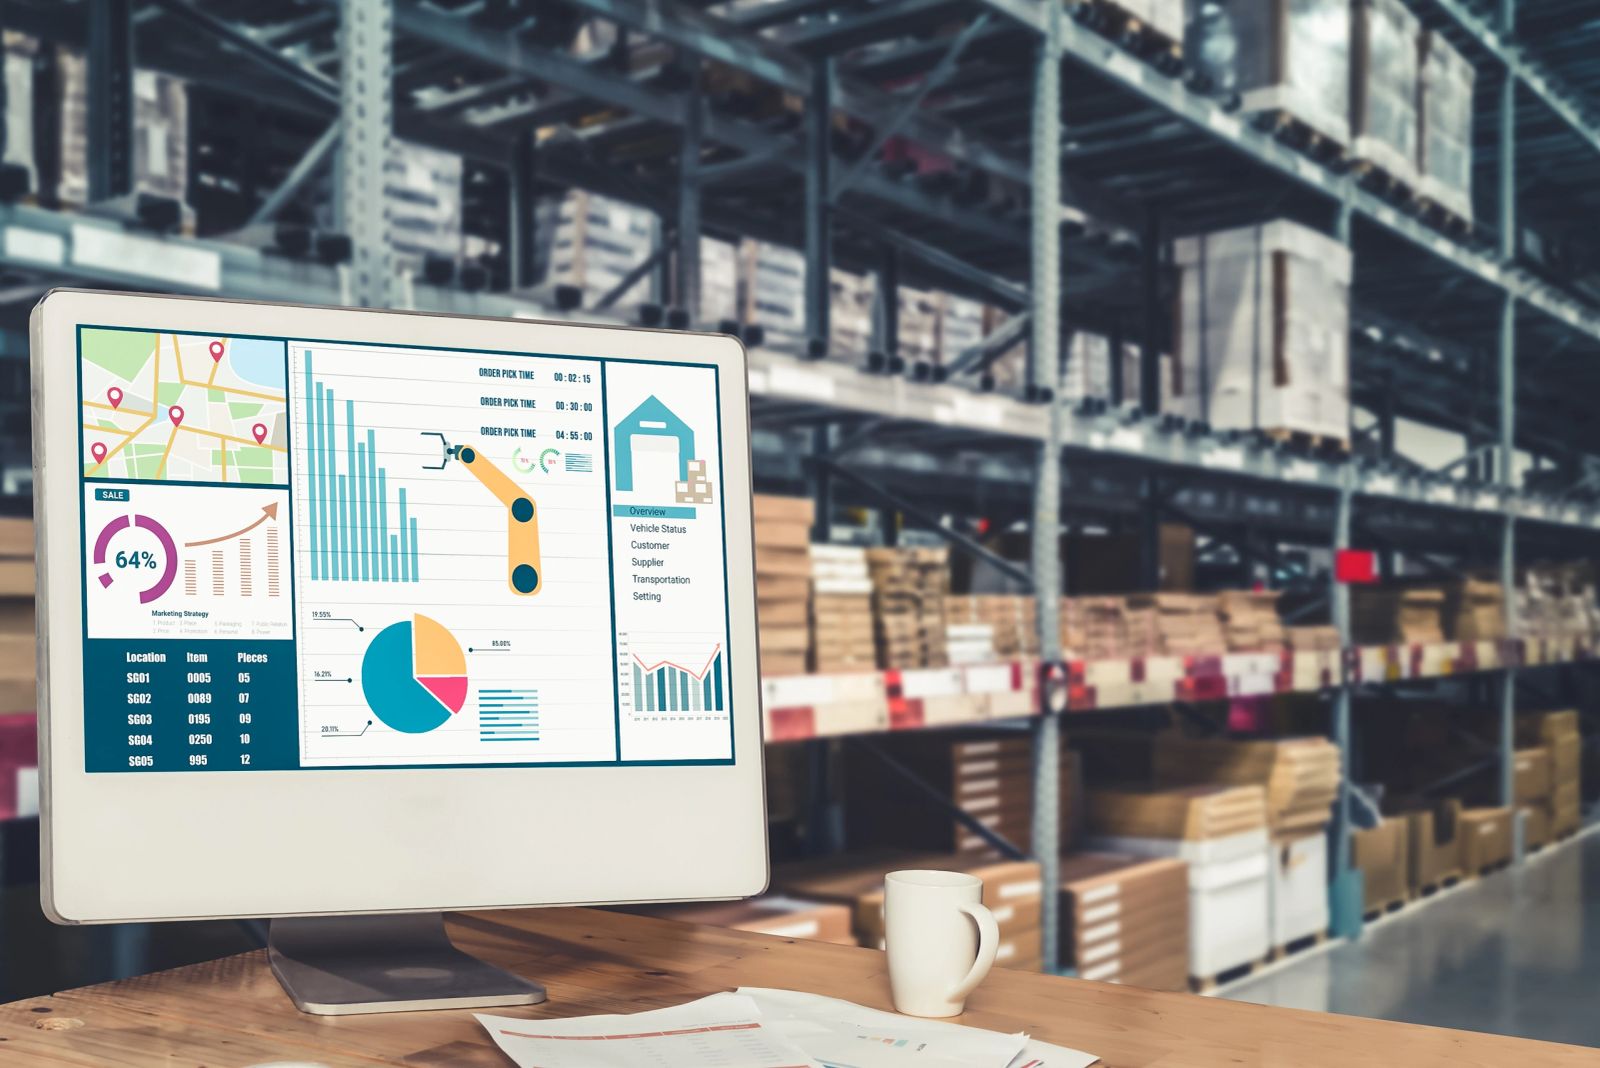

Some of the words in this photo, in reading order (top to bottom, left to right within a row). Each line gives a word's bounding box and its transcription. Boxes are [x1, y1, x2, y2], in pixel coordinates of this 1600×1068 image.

[479, 368, 500, 377] ORDER
[502, 369, 517, 378] PICK
[519, 370, 534, 379] TIME
[481, 397, 502, 406] ORDER
[504, 398, 518, 407] PICK
[520, 399, 536, 408] TIME
[481, 427, 502, 436] ORDER
[504, 428, 519, 437] PICK
[520, 429, 536, 438] TIME
[103, 491, 123, 499] SALE
[629, 506, 666, 516] Overview
[630, 524, 659, 532] Vehicle
[661, 525, 686, 533] Status
[631, 541, 669, 549] Customer
[116, 551, 156, 569] 64%
[632, 558, 664, 568] Supplier
[632, 575, 690, 585] Transportation
[633, 592, 661, 602] Setting
[152, 610, 182, 618] Marketing
[184, 611, 208, 619] Strategy
[127, 652, 166, 662] Location
[187, 652, 207, 662] Item
[238, 653, 267, 662] Pieces
[128, 693, 151, 704] SG02
[188, 693, 211, 703] 0089
[239, 693, 249, 703] 07
[128, 714, 152, 724] SG03
[189, 714, 210, 724] 0195
[240, 713, 251, 723] 09
[128, 735, 152, 745] SG04
[189, 734, 212, 744] 0250
[240, 734, 250, 744] 10
[129, 756, 153, 766] SG05
[190, 755, 207, 765] 995
[240, 754, 250, 764] 12
